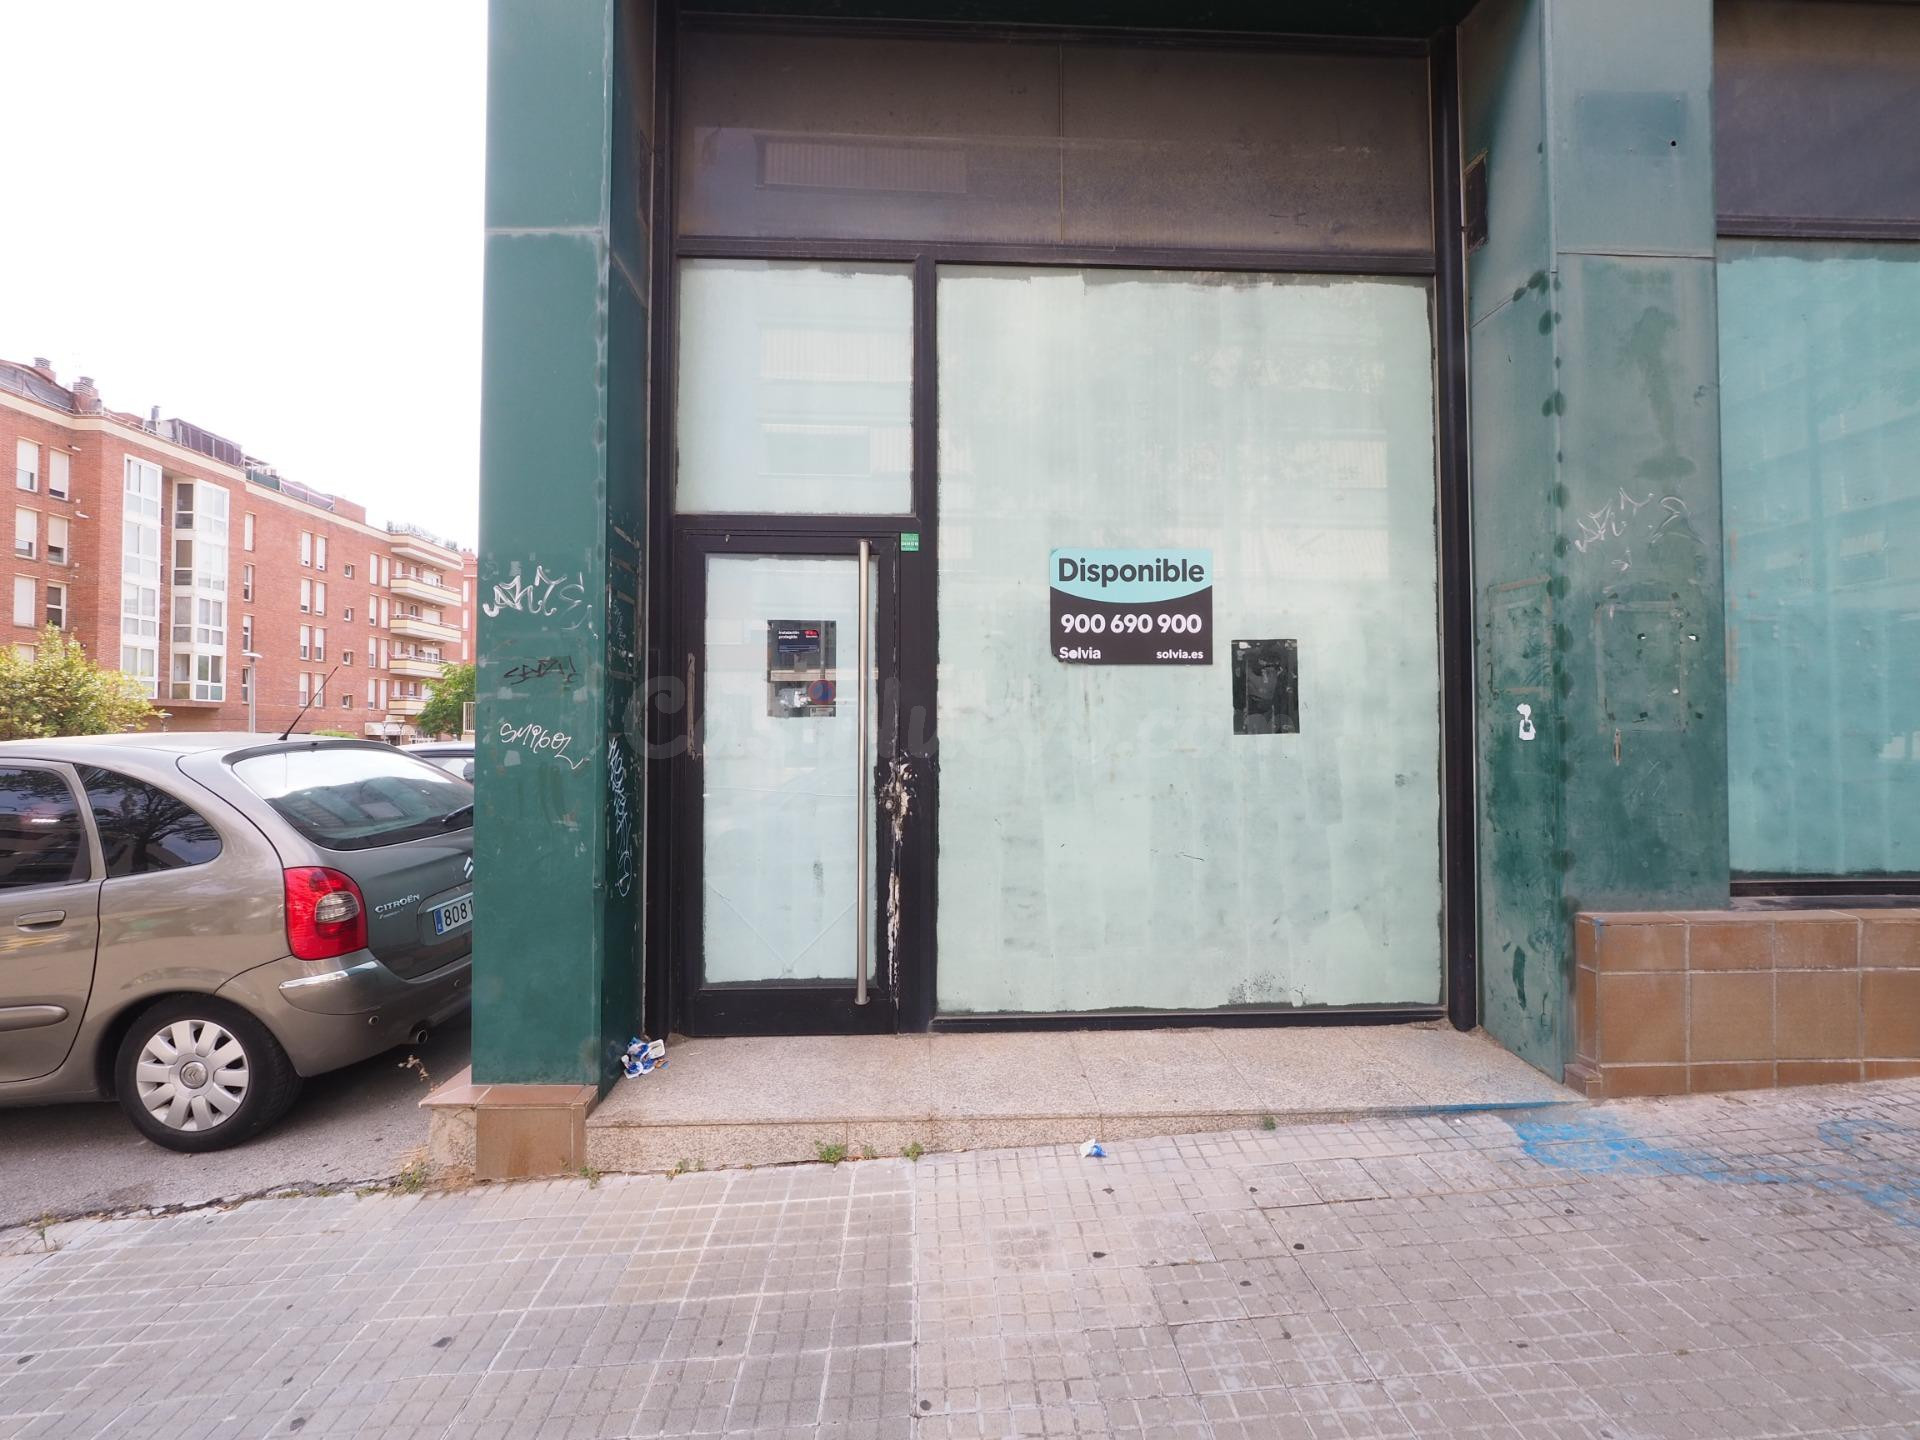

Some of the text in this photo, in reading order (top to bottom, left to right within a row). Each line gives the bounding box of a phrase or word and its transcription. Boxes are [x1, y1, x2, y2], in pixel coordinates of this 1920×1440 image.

[1058, 557, 1205, 588] Disponible
[1060, 613, 1203, 634] 900 690 900
[1059, 646, 1204, 660] Solvia solvia.es
